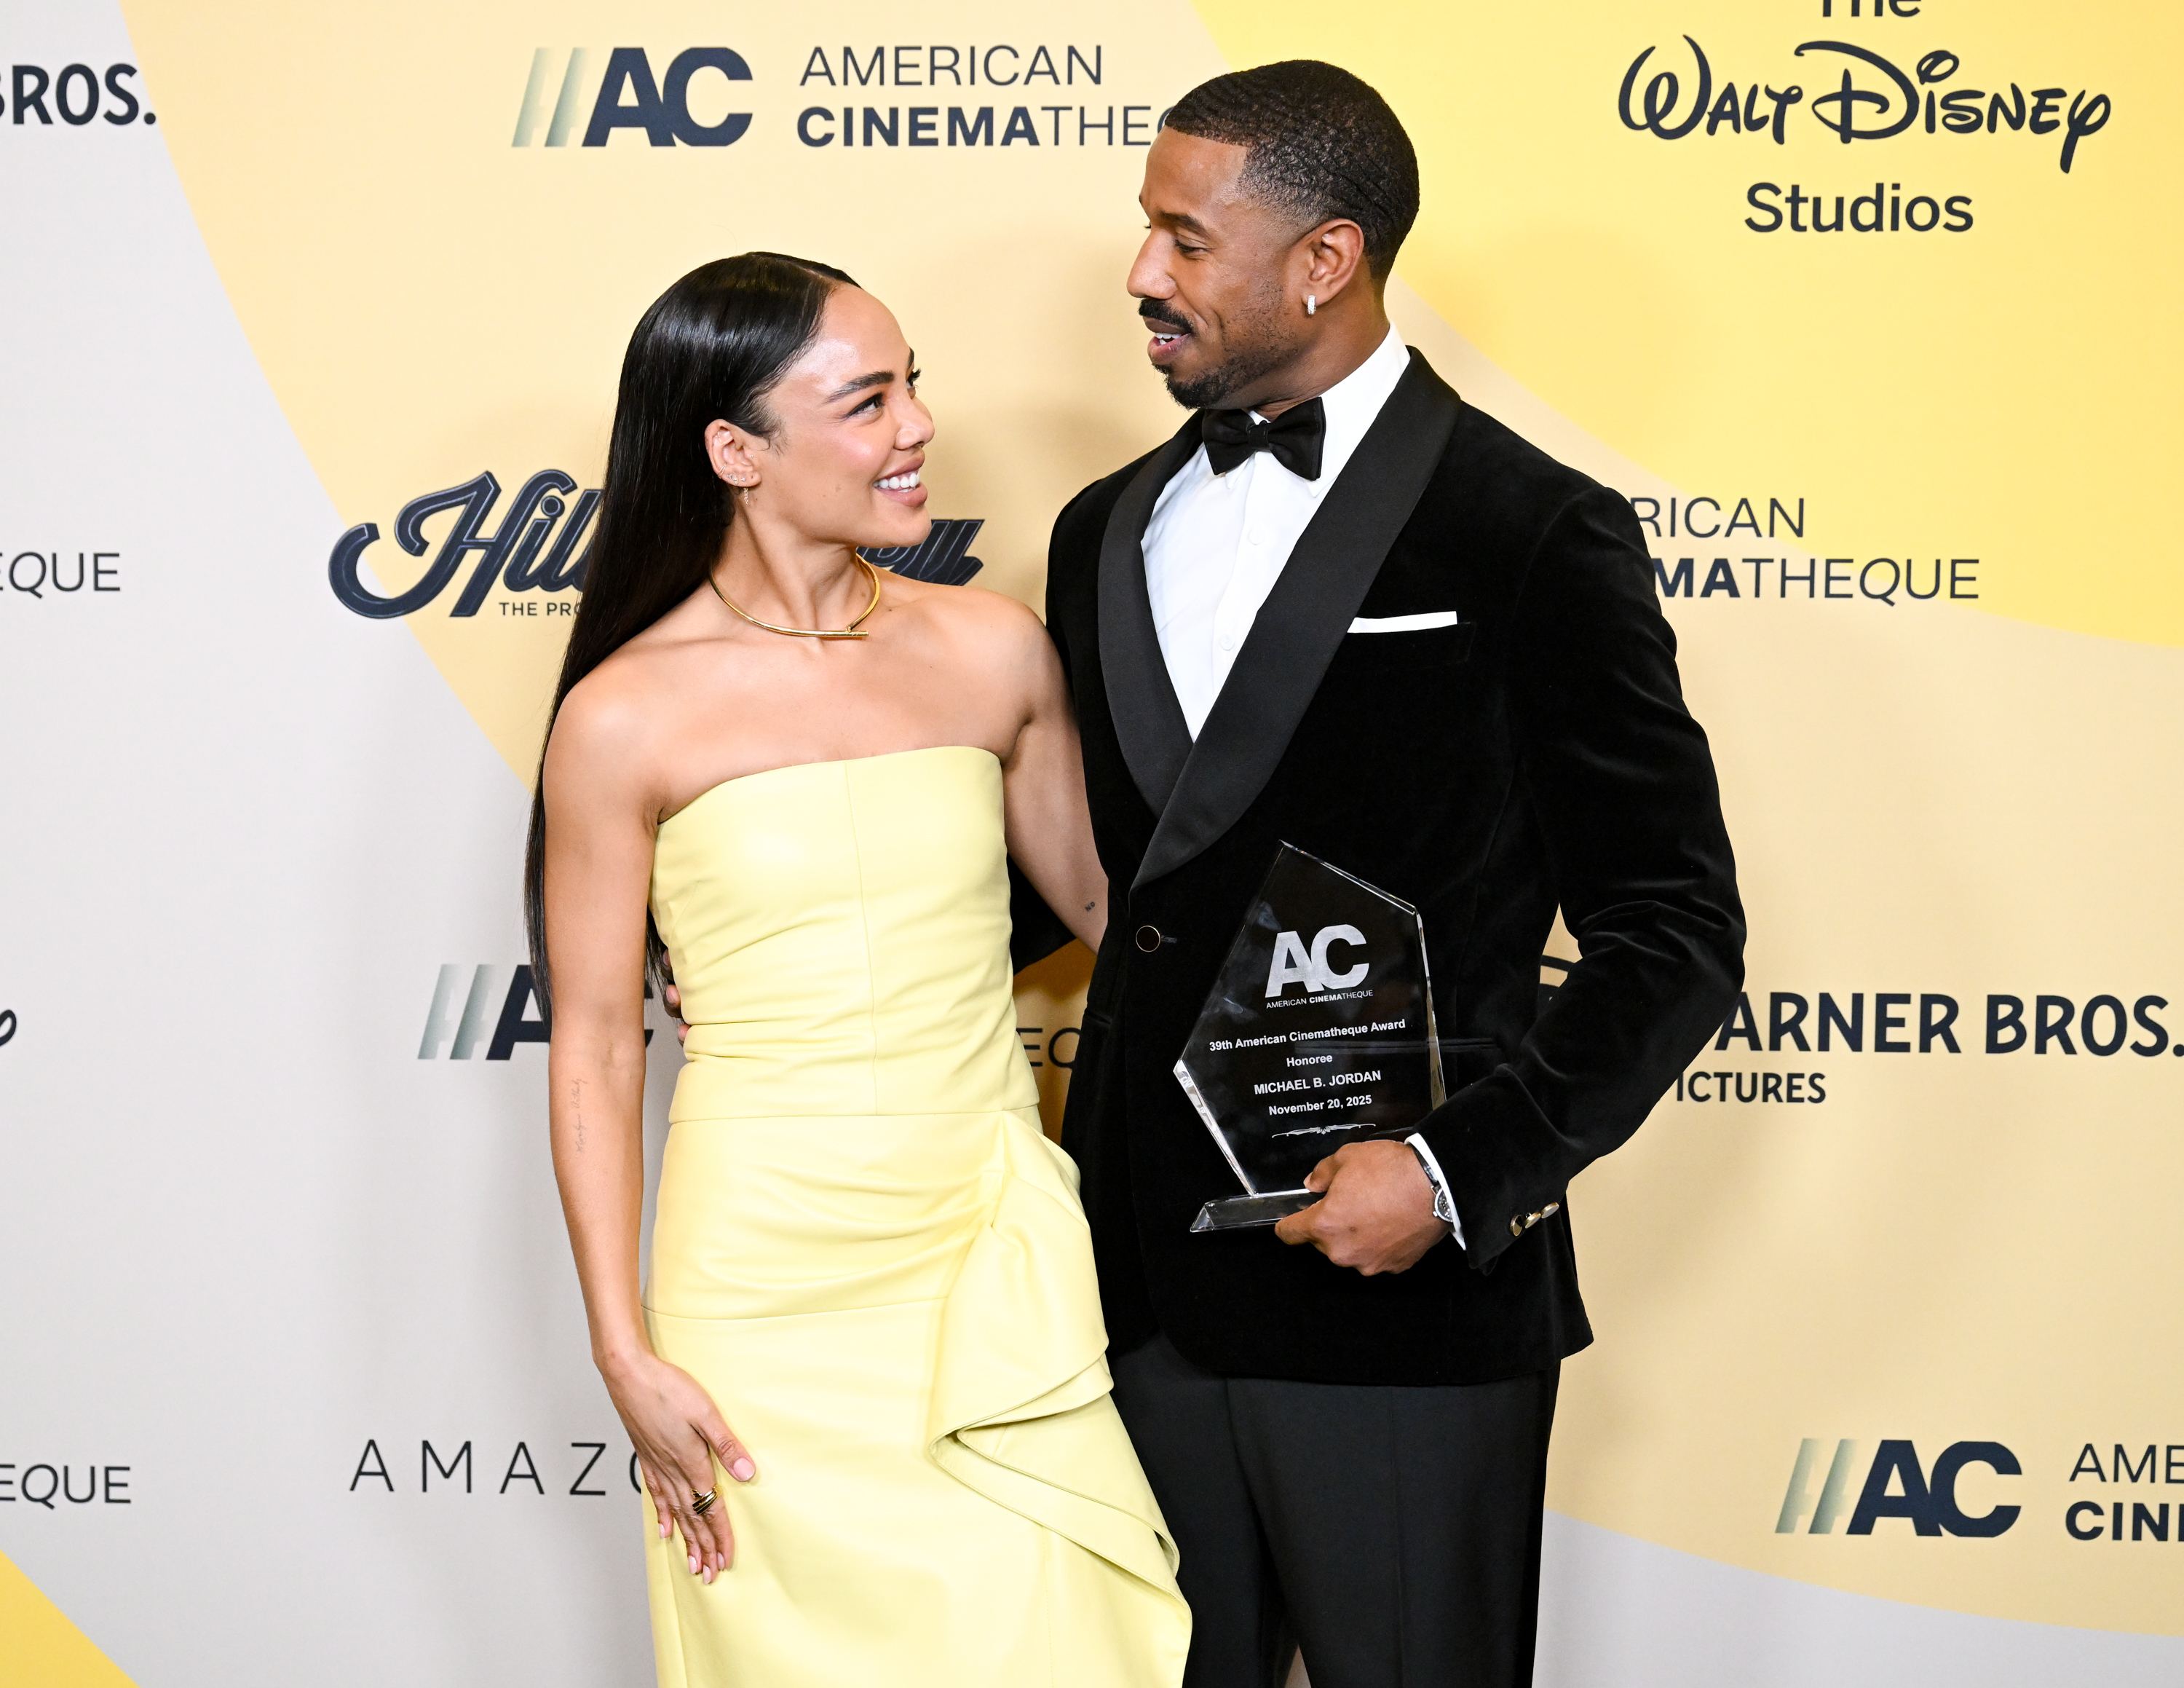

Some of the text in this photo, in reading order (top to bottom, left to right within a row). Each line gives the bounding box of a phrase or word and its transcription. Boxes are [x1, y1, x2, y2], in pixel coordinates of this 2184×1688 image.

[799, 45, 1102, 86] AMERICAN
[0, 63, 157, 126] ROS.
[1744, 182, 1974, 233] Studios
[0, 551, 121, 599] QUE
[499, 602, 537, 616] THE
[1265, 924, 1369, 998] AC
[1266, 990, 1374, 1009] AMERICAN CINEMATHEQUE
[1209, 1019, 1406, 1052] 39th American Cinematheque Award
[1985, 994, 2184, 1057] BROS.
[1286, 1054, 1333, 1068] Honoree
[1254, 1070, 1381, 1095] MICHAEL B. JORDAN
[1269, 1095, 1372, 1115] November 20, 2025
[2065, 1500, 2184, 1542] CIN
